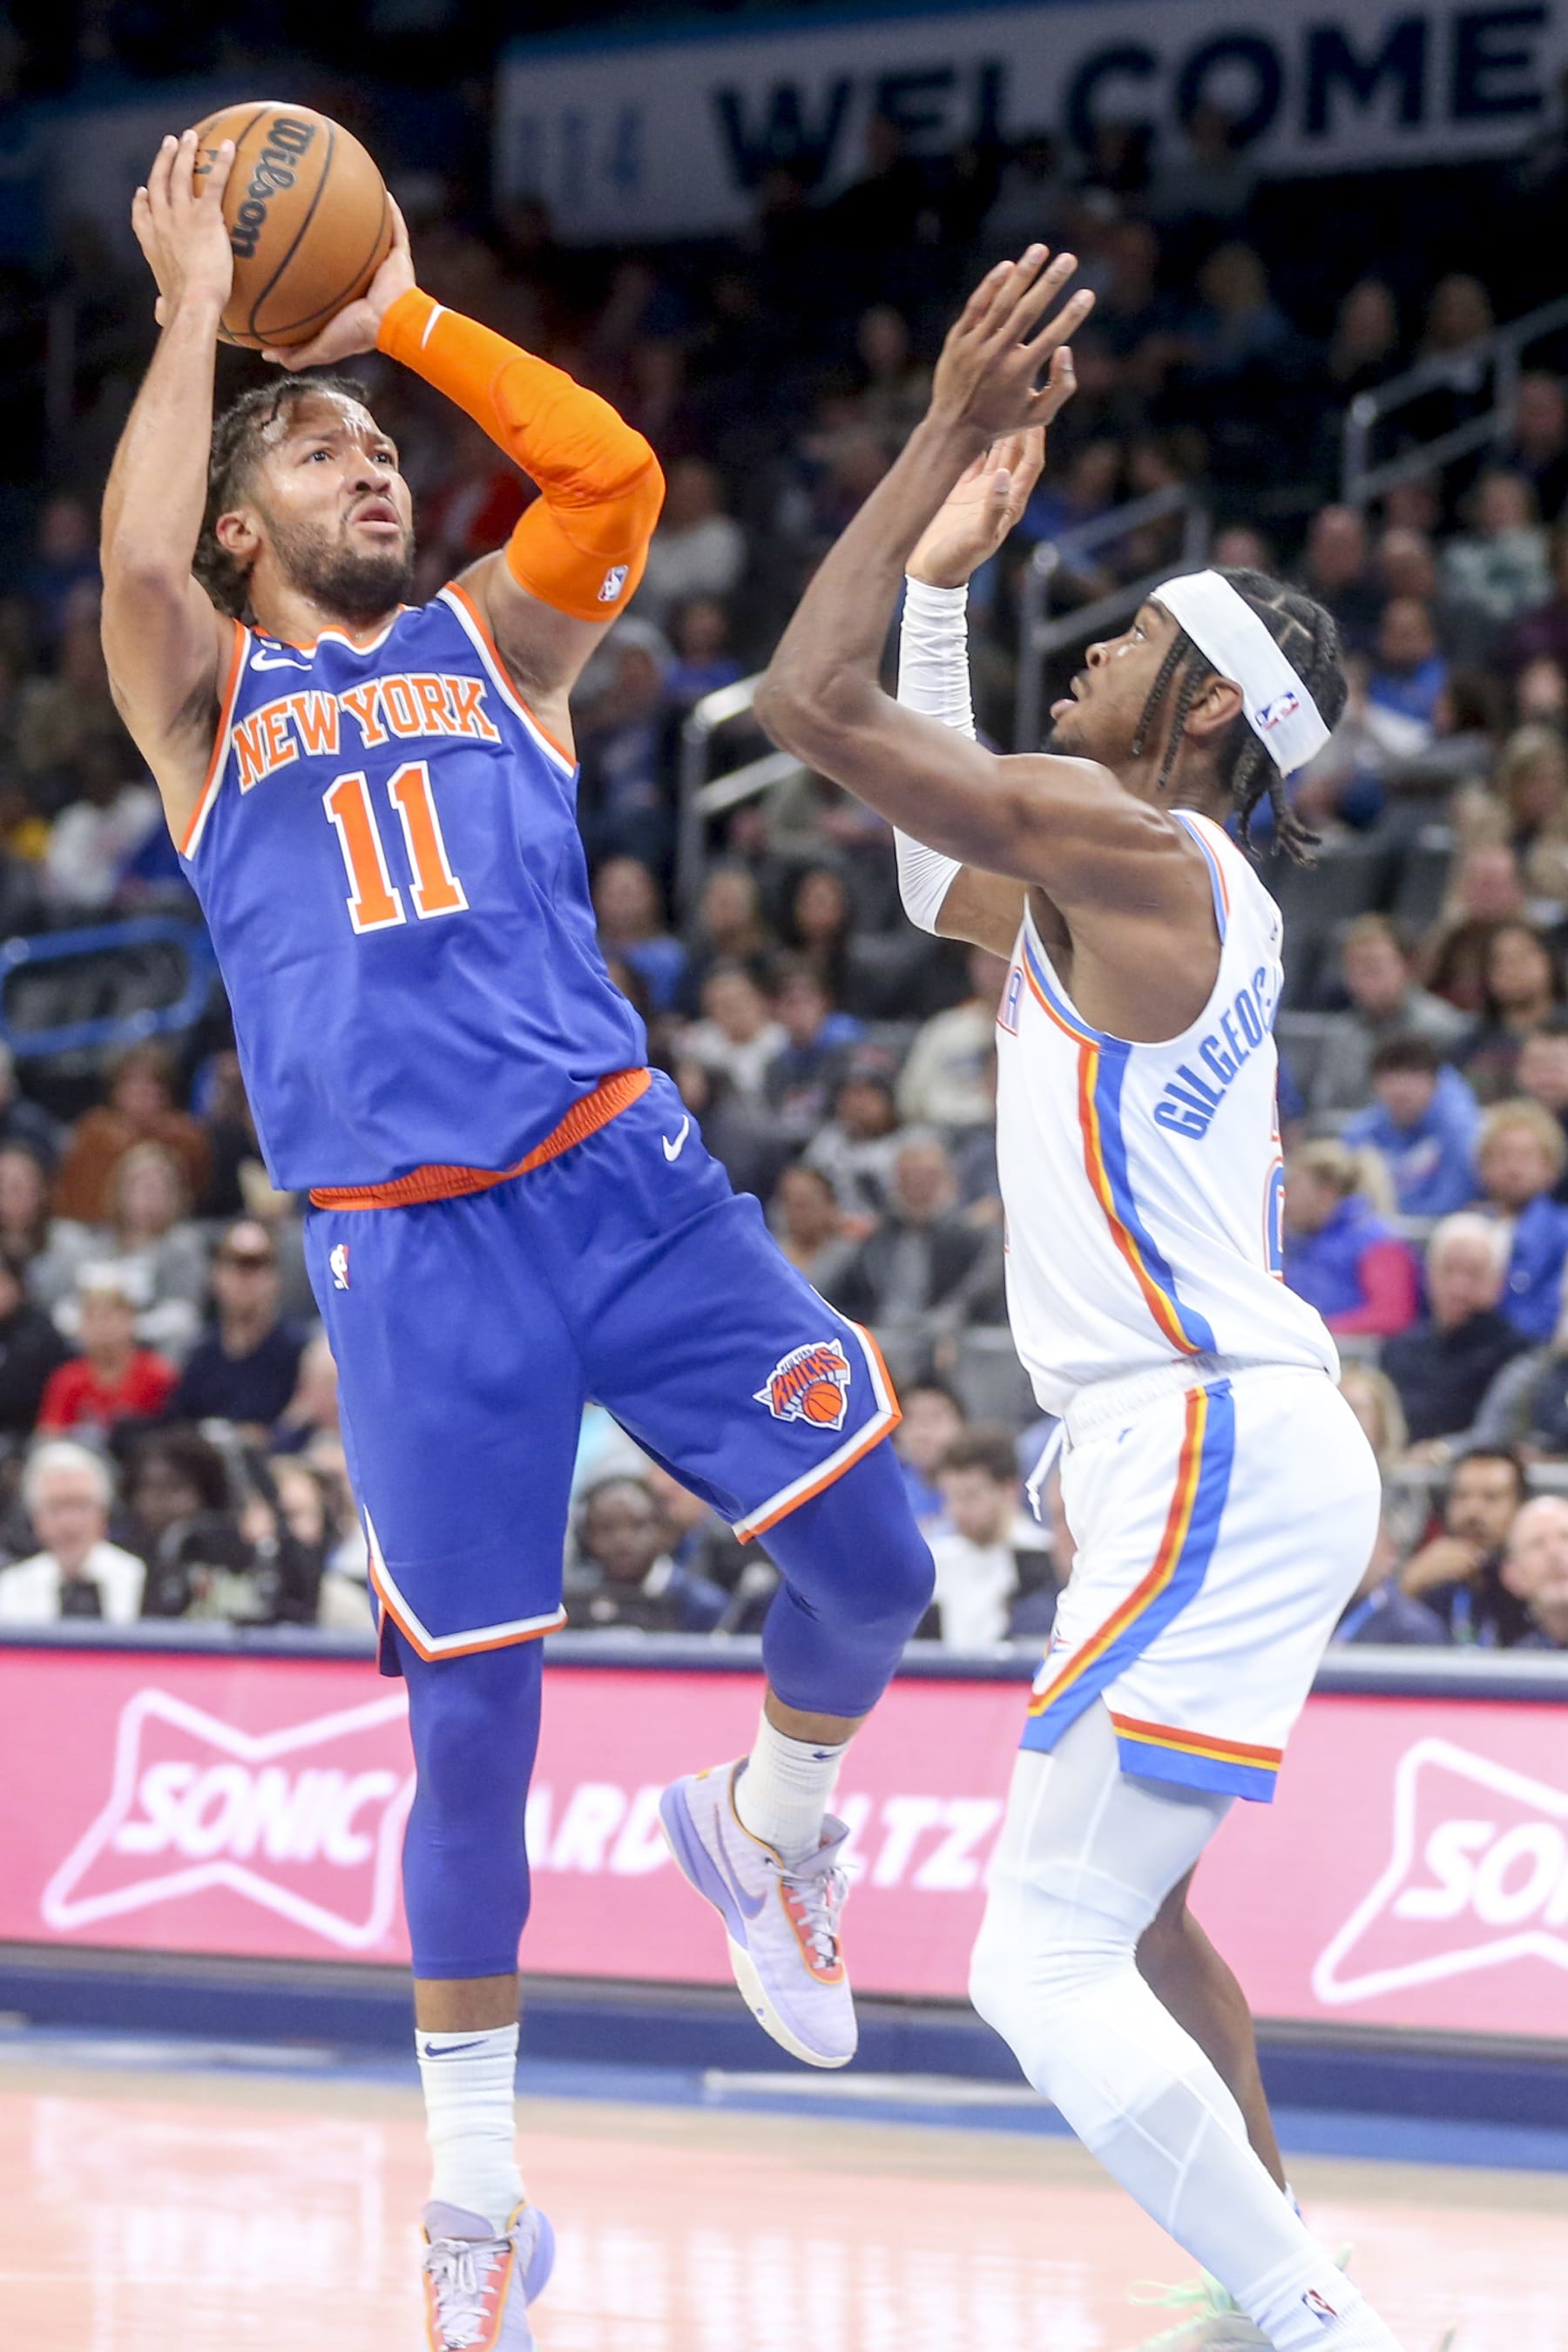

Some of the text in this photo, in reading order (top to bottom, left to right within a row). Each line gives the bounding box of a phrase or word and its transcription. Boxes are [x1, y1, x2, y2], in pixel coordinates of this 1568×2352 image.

[714, 5, 1546, 192] WELCOME
[230, 118, 315, 259] Wilson
[232, 672, 502, 794] NEW YORK
[322, 760, 470, 935] 11
[770, 1346, 848, 1416] KNICKS
[113, 1762, 398, 1866] SONIC
[524, 1781, 674, 1875] ARD
